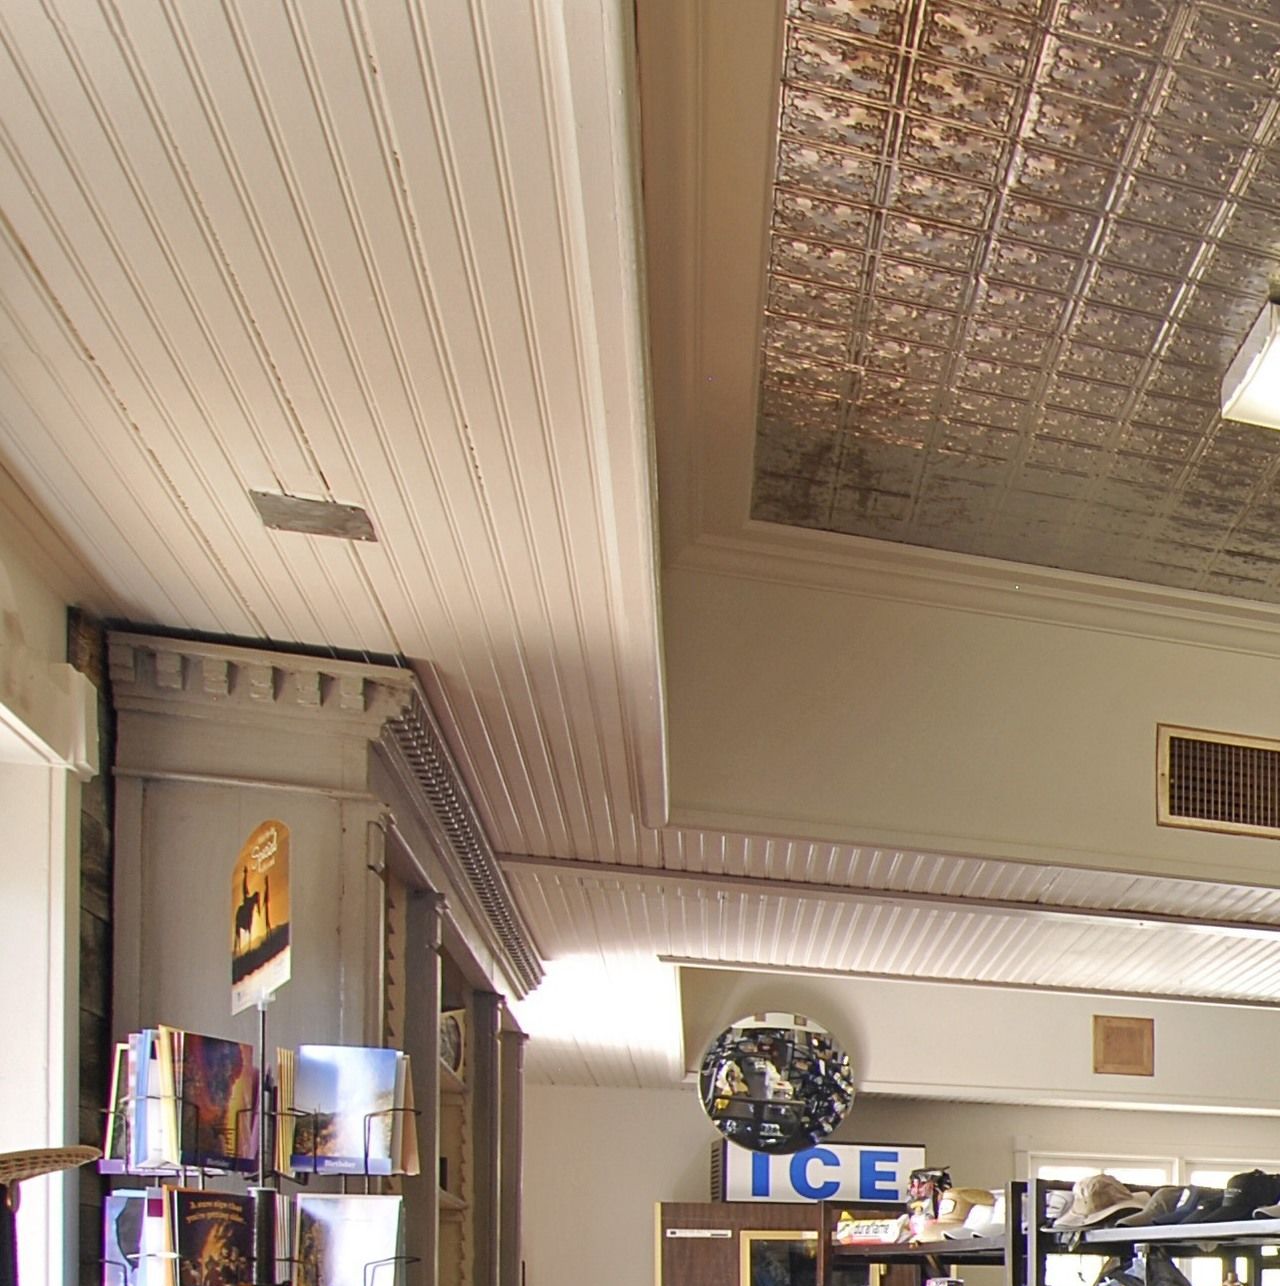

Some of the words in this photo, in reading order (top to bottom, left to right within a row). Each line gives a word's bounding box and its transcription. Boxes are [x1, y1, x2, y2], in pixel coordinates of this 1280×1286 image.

[324, 1159, 356, 1169] Birthday
[752, 1145, 899, 1200] ICE
[853, 1222, 890, 1236] duraflame
